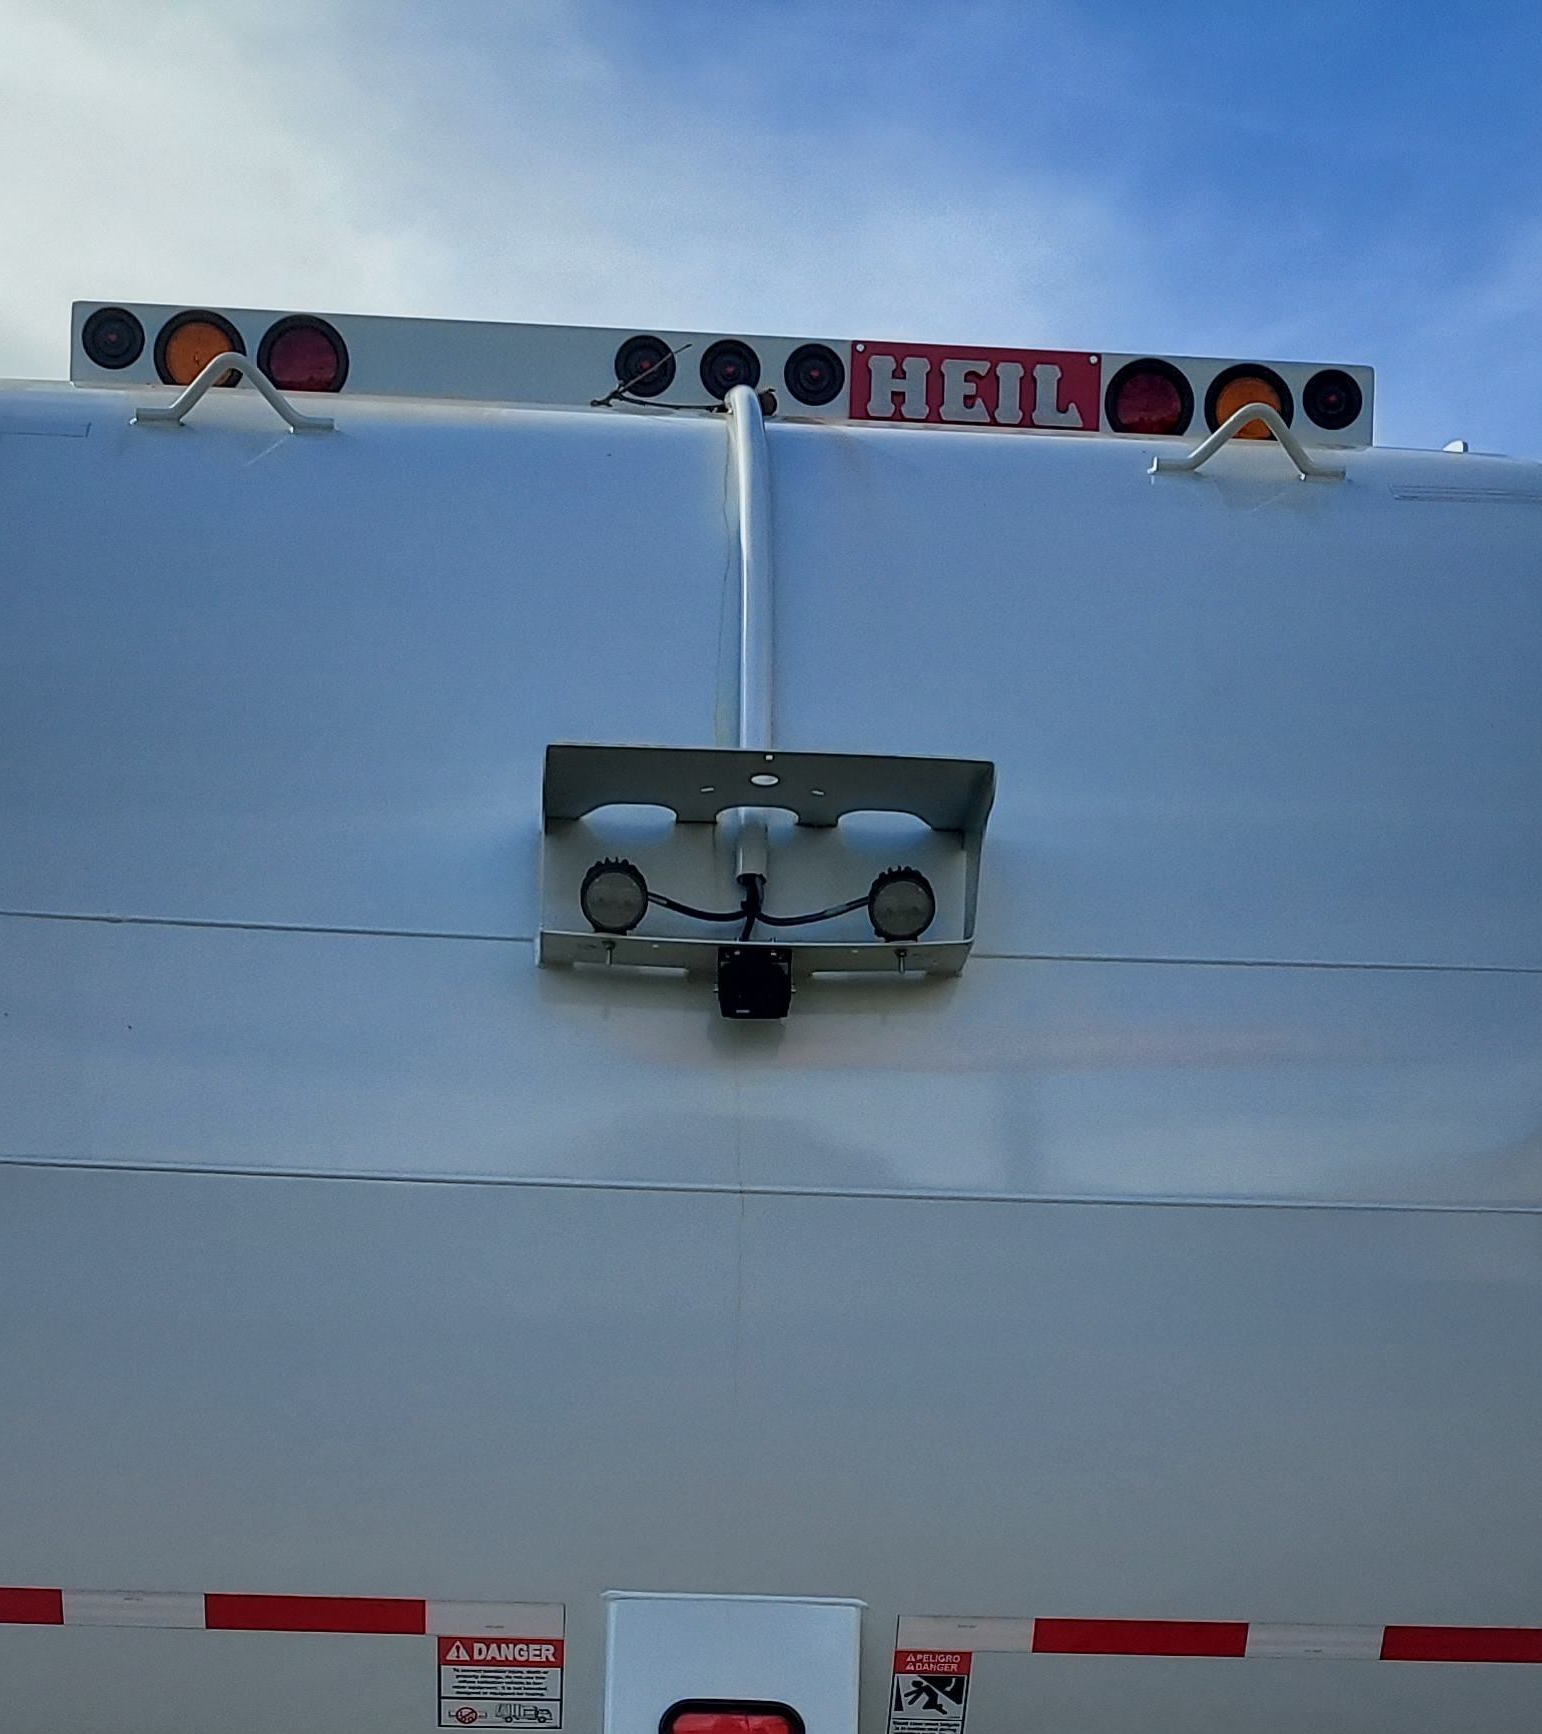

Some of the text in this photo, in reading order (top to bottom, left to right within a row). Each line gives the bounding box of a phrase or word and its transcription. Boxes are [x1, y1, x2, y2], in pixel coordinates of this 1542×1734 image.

[867, 355, 1083, 428] HEIL
[473, 1643, 556, 1662] DANGER
[916, 1654, 961, 1663] PELIGRO
[915, 1662, 958, 1672] DANGER
